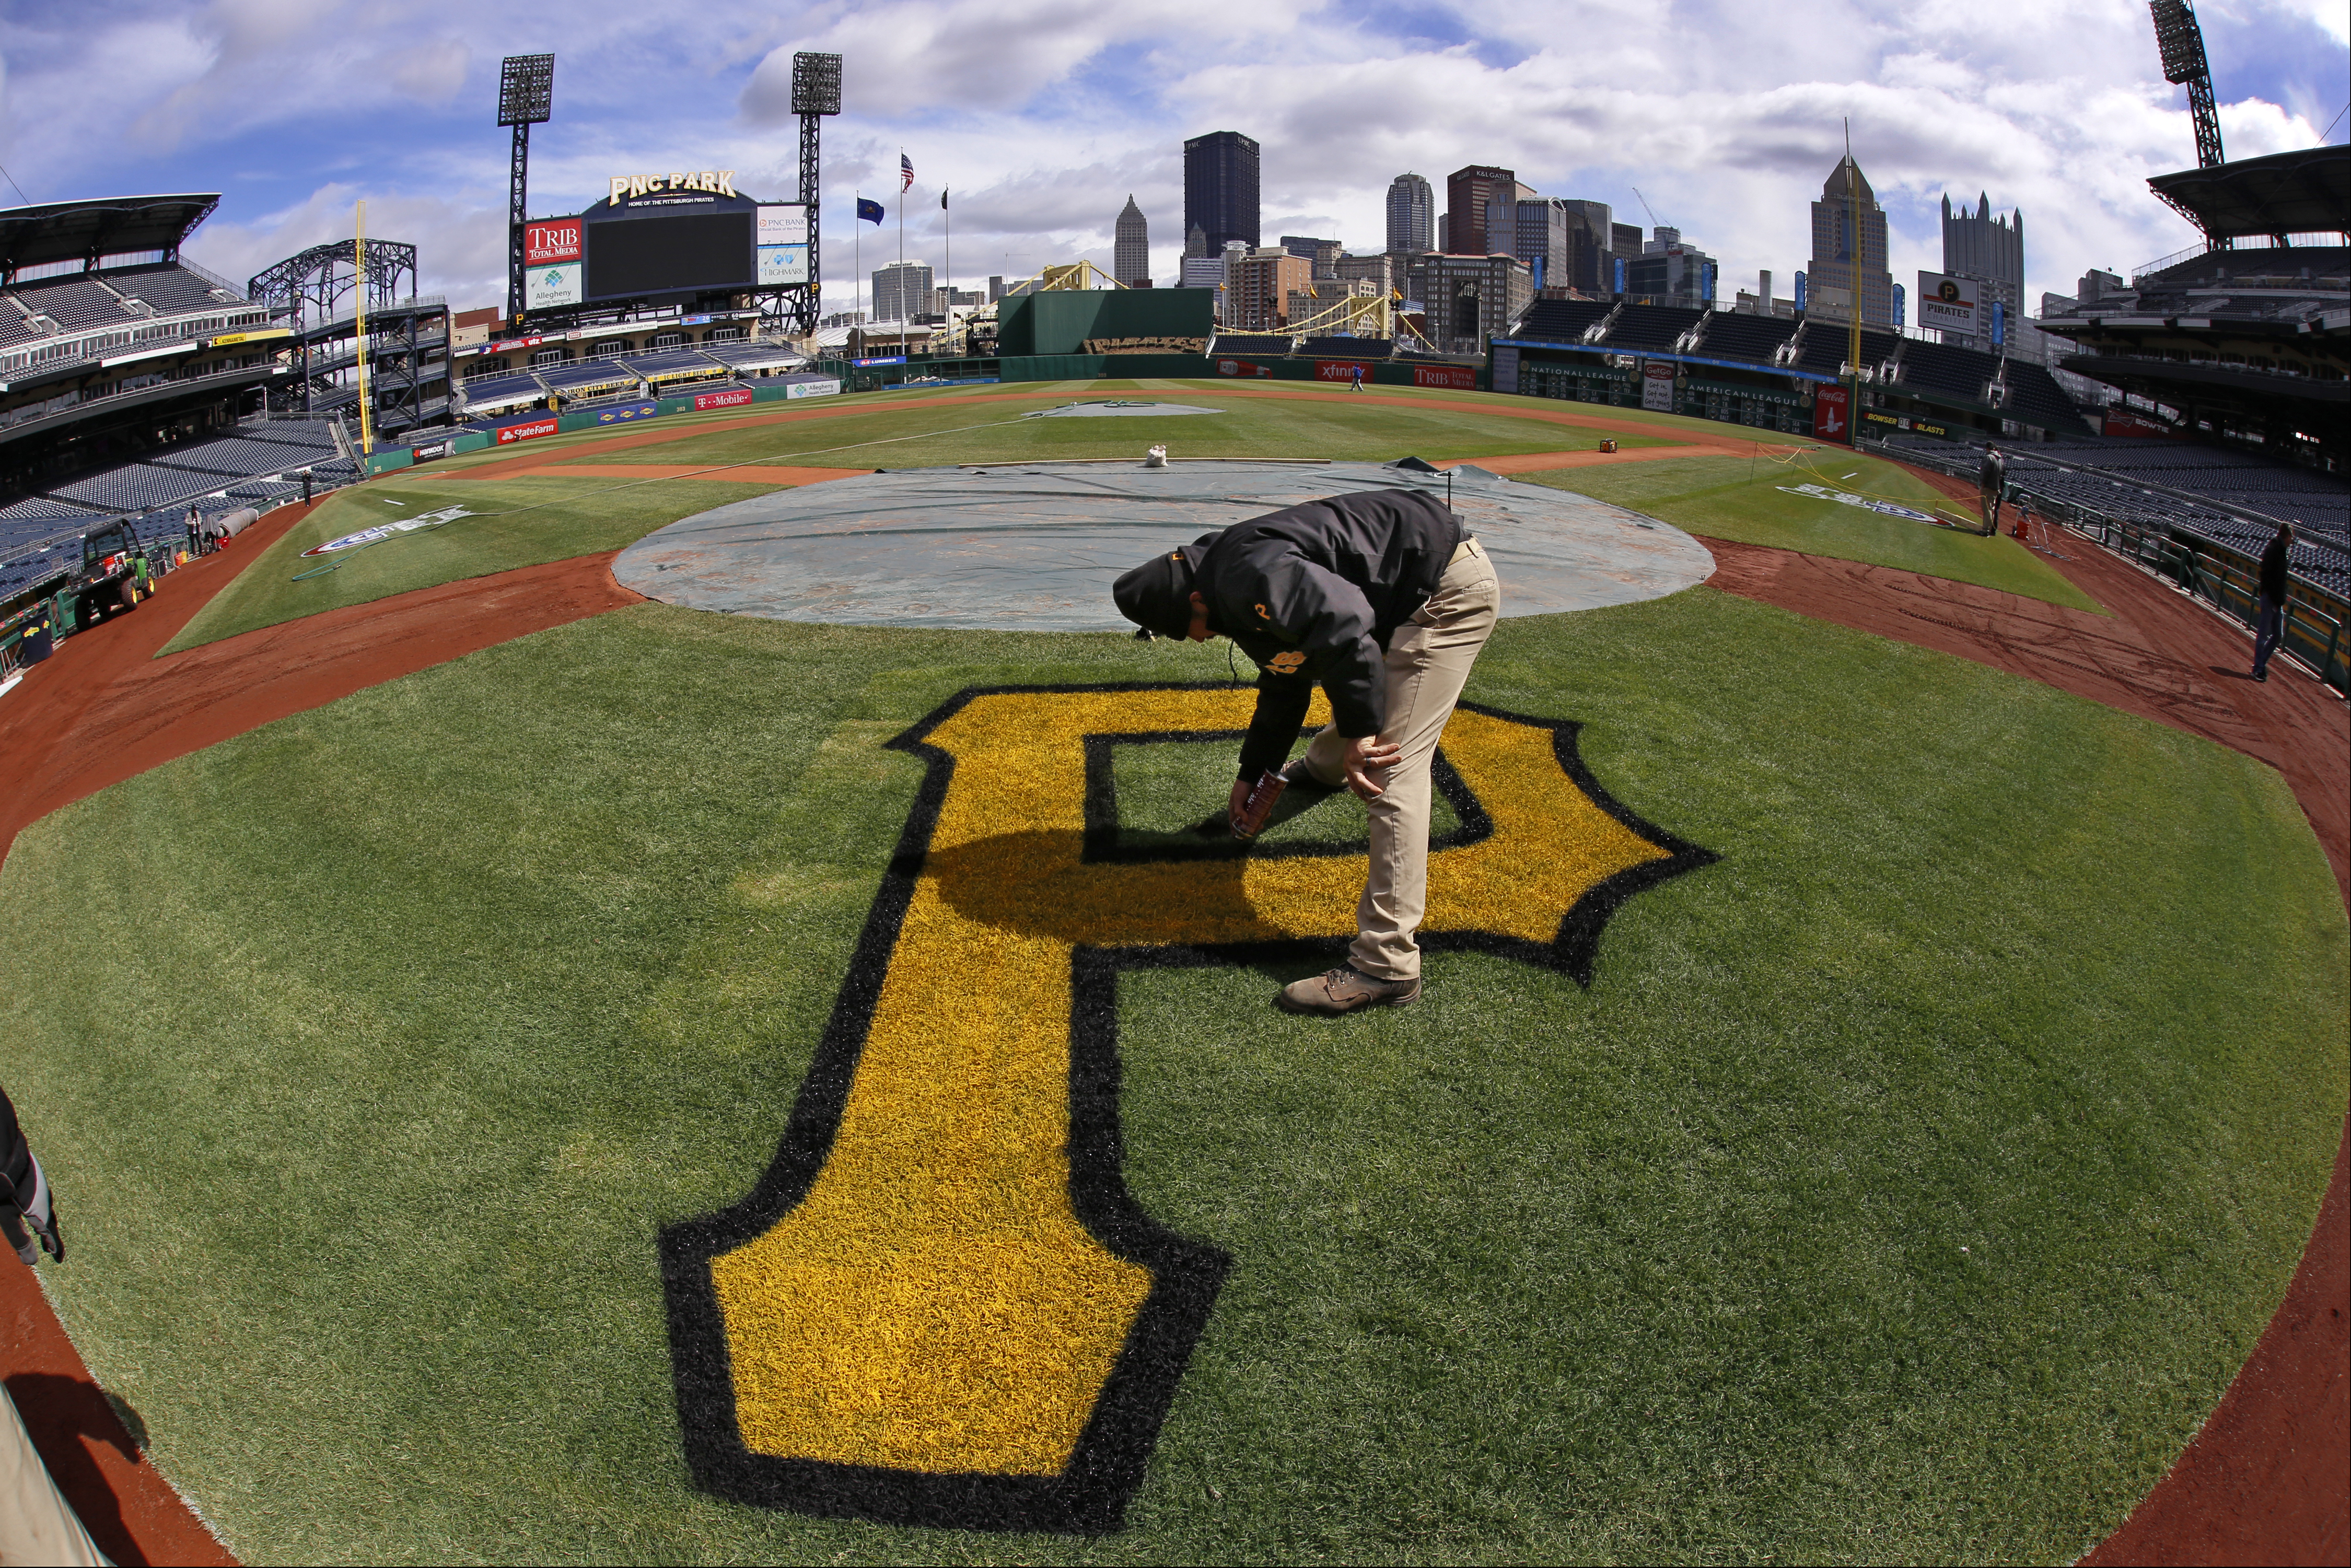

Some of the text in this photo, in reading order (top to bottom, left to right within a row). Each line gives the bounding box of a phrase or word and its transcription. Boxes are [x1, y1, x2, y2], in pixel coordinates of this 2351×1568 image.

[1184, 141, 1201, 150] UPMC
[1238, 136, 1250, 147] UPMC
[609, 170, 737, 206] PNC PARK
[528, 227, 578, 249] TRIB
[555, 247, 578, 255] MEDIA
[536, 290, 572, 299] Allegheny
[811, 284, 819, 293] P
[1944, 285, 1954, 299] P
[1927, 303, 1970, 319] PIRATES
[516, 313, 523, 325] P
[1927, 313, 1970, 325] CHARITIES
[1415, 369, 1448, 384] TRIB
[1451, 371, 1473, 380] TOTAL
[1531, 367, 1626, 381] NATIONAL LEAGUE
[1647, 367, 1671, 375] GetGo
[1647, 390, 1657, 399] Get
[1689, 384, 1797, 406] AMERICAN LEAGUE
[1645, 398, 1671, 408] Get going.
[1868, 413, 1898, 425] BOWSER
[1917, 424, 1945, 435] BLASTS
[2135, 418, 2169, 434] BOWTIE
[1254, 603, 1271, 621] P
[659, 682, 1714, 1537] P
